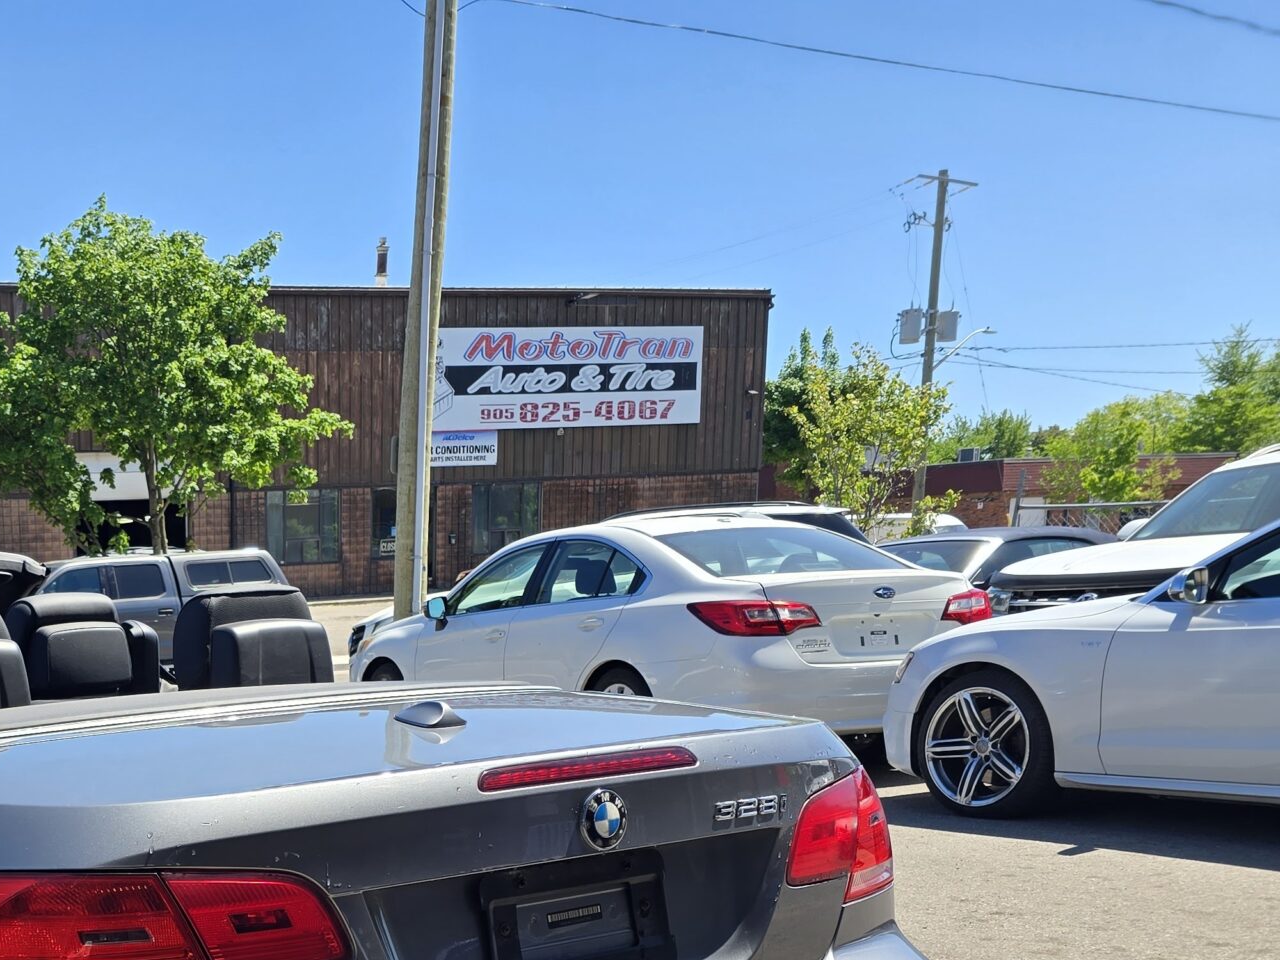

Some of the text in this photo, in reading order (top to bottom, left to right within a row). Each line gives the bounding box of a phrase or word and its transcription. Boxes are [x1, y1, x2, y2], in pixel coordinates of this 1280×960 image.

[464, 331, 694, 361] MotoTran
[467, 364, 675, 393] Auto & Tire
[480, 399, 676, 423] 905 825-4067
[435, 445, 495, 455] CONDITIONING
[715, 793, 787, 821] 328i
